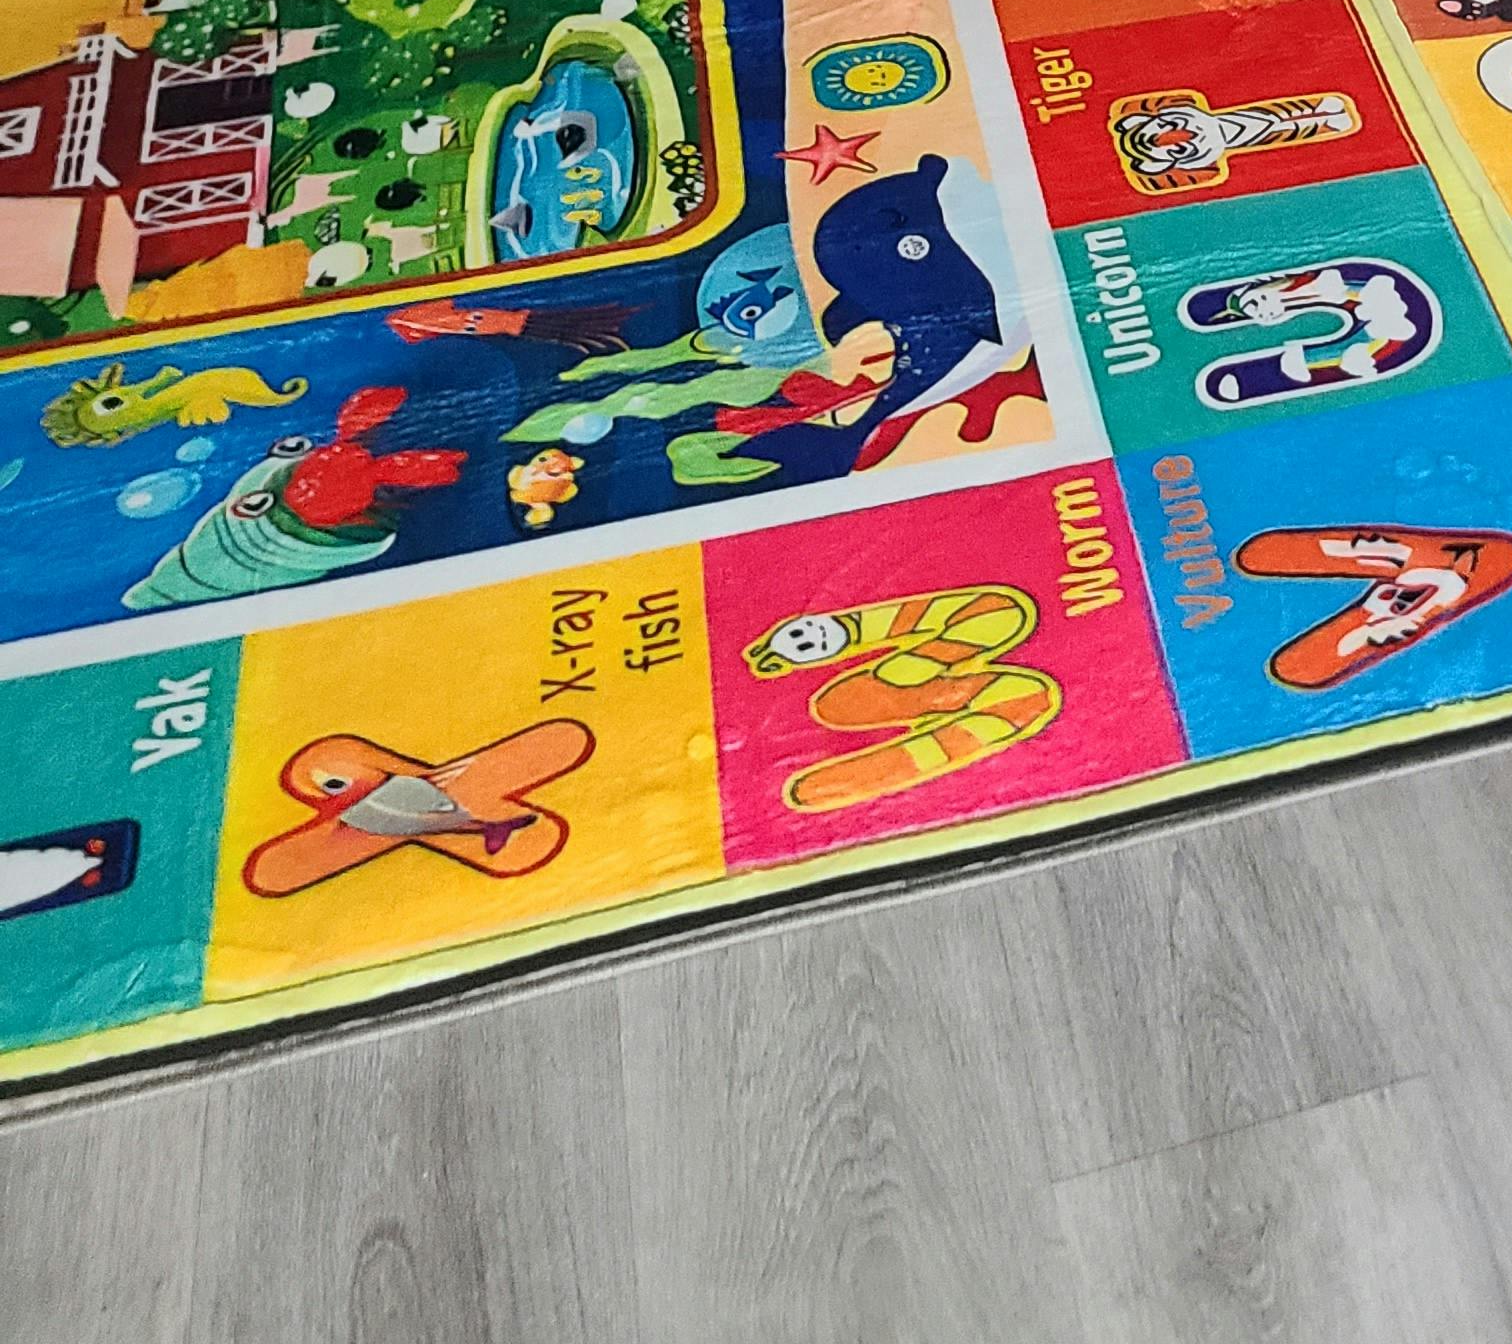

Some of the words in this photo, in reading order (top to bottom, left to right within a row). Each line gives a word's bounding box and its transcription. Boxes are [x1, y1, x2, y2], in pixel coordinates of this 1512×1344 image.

[1029, 45, 1094, 126] Tiger
[1082, 224, 1162, 378] Unicorn
[1049, 475, 1124, 620] Worm
[1150, 452, 1236, 631] Vulture
[539, 587, 610, 705] X-ray
[623, 587, 685, 675] fish
[129, 665, 214, 775] Yak
